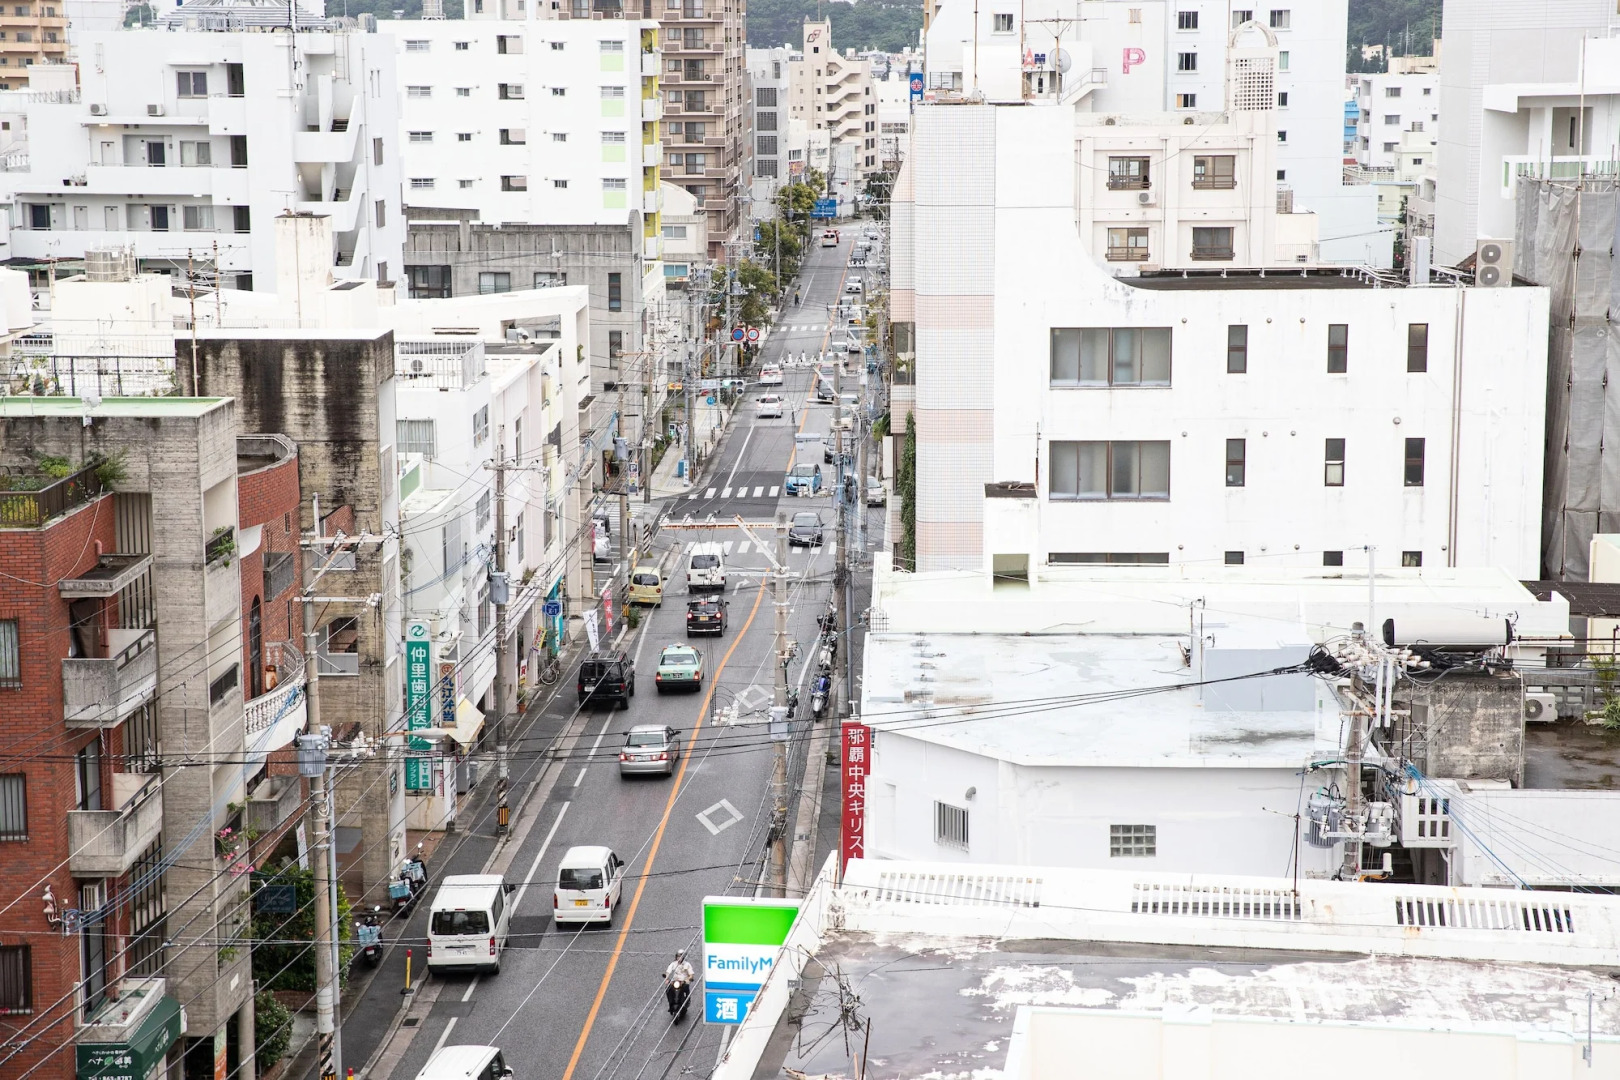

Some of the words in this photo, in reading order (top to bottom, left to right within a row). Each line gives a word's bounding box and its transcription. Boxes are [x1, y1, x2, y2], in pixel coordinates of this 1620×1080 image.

[1123, 48, 1146, 74] P
[848, 728, 865, 859] 那覇中央キリス
[708, 955, 773, 974] FamilyM
[716, 997, 738, 1020] 酒
